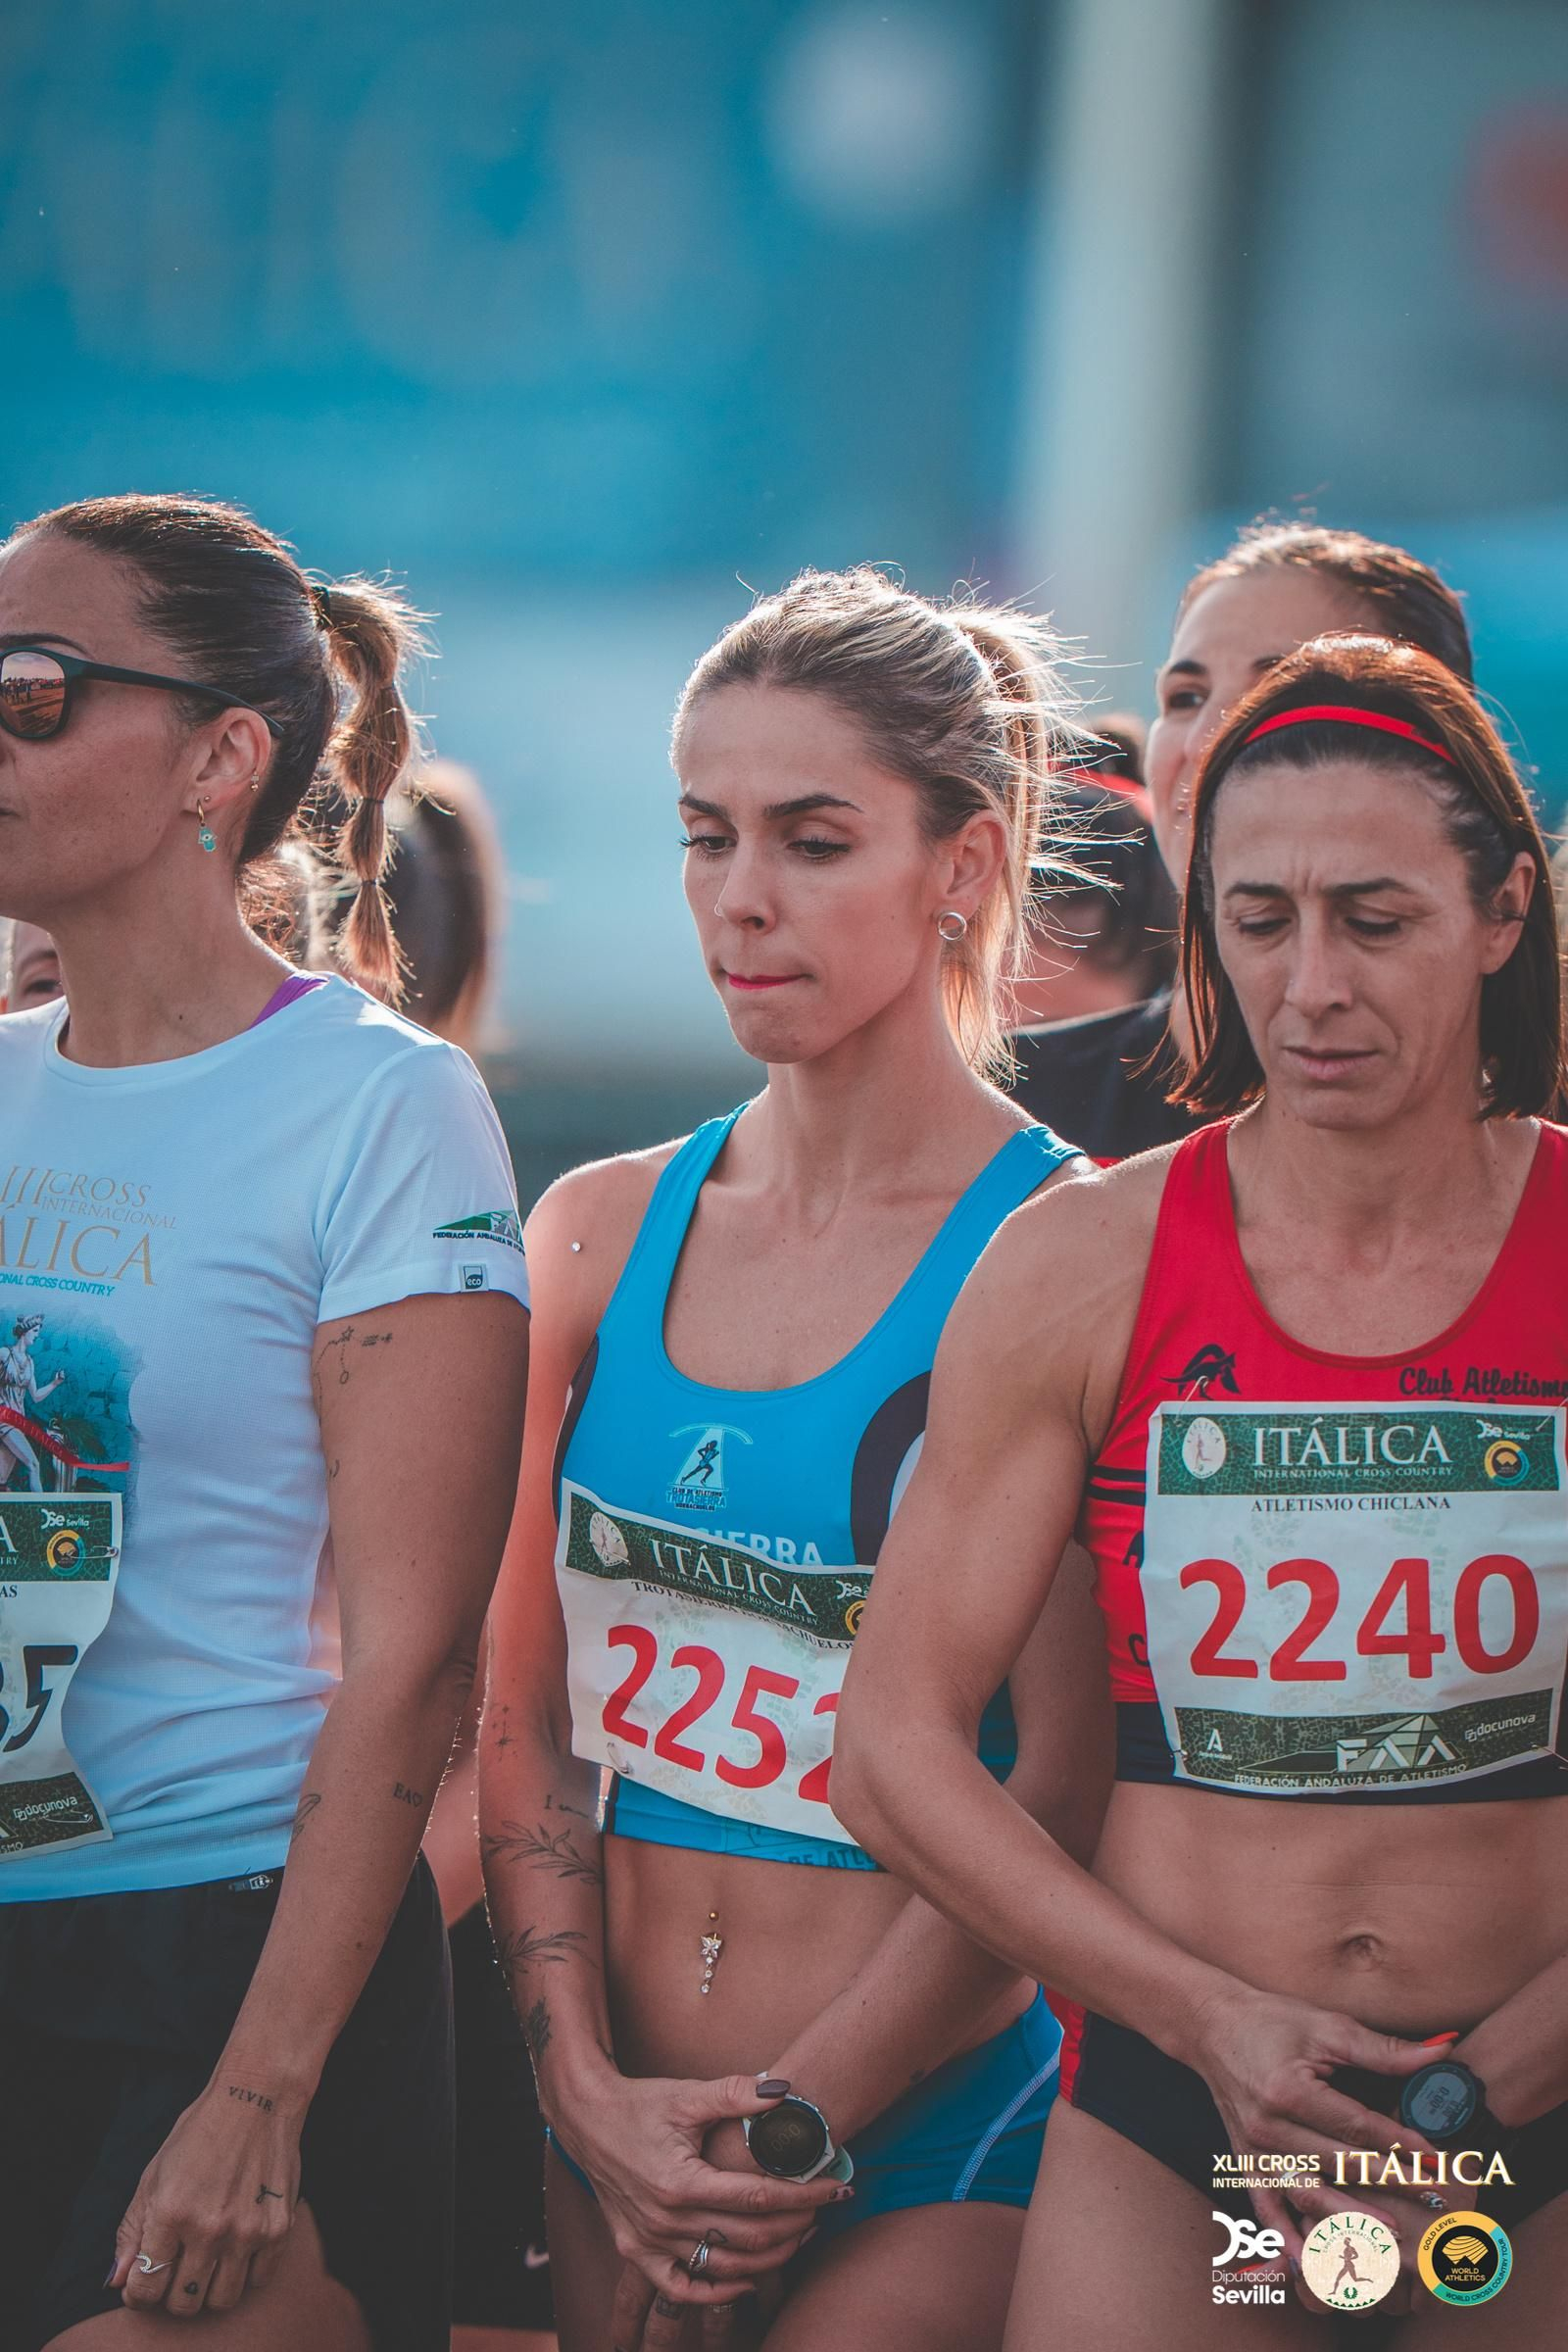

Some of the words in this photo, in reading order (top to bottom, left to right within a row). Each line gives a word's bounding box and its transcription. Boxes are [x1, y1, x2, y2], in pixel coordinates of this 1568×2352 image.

[50, 1172, 151, 1207] CROSS
[41, 1196, 178, 1229] INTERNACIONAL
[25, 1275, 58, 1289] CROSS
[59, 1279, 115, 1297] COUNTRY
[466, 1277, 481, 1286] eco
[1399, 1366, 1453, 1396] Club
[1252, 1416, 1453, 1466] ITÁLICA
[1254, 1468, 1350, 1479] INTERNATIONAL
[1354, 1468, 1391, 1478] CROSS
[1395, 1466, 1453, 1477] COUNTRY
[1251, 1497, 1353, 1512] ATLETISMO
[1358, 1495, 1451, 1511] CHICLANA
[649, 1539, 817, 1617] ITÁLICA
[660, 1570, 739, 1599] INTERNATIONAL
[742, 1592, 772, 1608] CROSS
[774, 1605, 818, 1626] COUNTRY
[1179, 1554, 1540, 1682] 2240
[1477, 1714, 1536, 1736] docunova
[1235, 1774, 1298, 1788] FEDERACIÓN
[1304, 1776, 1373, 1788] ANDALUZA
[1379, 1774, 1396, 1784] DE
[1401, 1763, 1467, 1782] ATLETISMO
[229, 2085, 273, 2112] VIVIR
